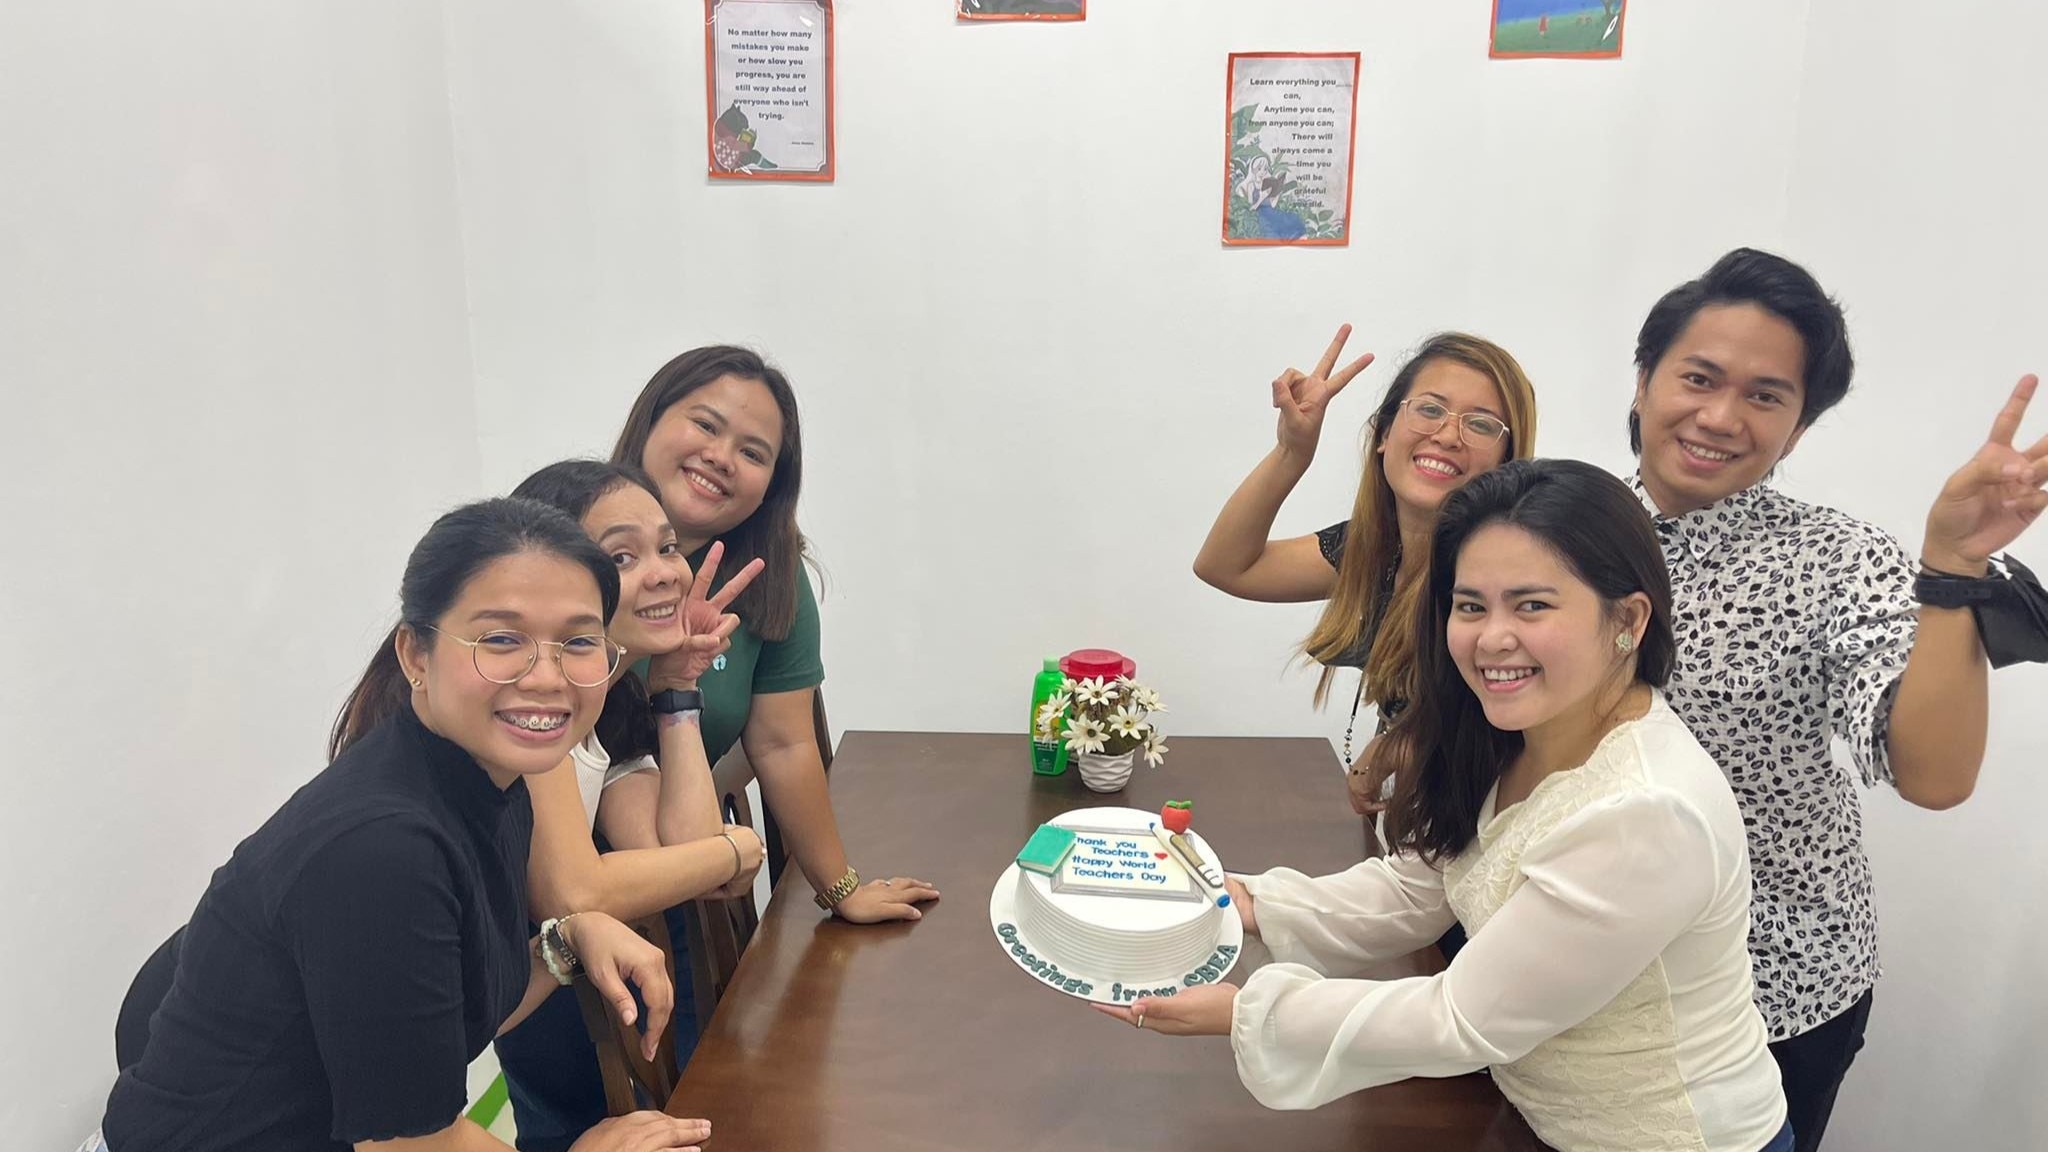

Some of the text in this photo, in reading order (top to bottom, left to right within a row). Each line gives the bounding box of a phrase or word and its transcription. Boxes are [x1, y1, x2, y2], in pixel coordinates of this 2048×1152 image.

[728, 28, 739, 36] No
[770, 29, 788, 37] how
[790, 31, 812, 39] many
[731, 43, 768, 51] mistakes
[767, 57, 786, 65] slow
[735, 71, 774, 79] progress,
[776, 72, 790, 80] you
[1275, 78, 1319, 87] everything
[1263, 105, 1335, 114] Anytime you can,
[758, 112, 784, 120] trying.
[1271, 147, 1300, 155] always
[1077, 837, 1137, 849] hank you
[1091, 846, 1149, 858] Teachers
[1072, 855, 1156, 870] Happy World
[1072, 867, 1166, 884] Teachers Day
[998, 923, 1094, 995] Greetings
[1183, 945, 1238, 987] CBEA
